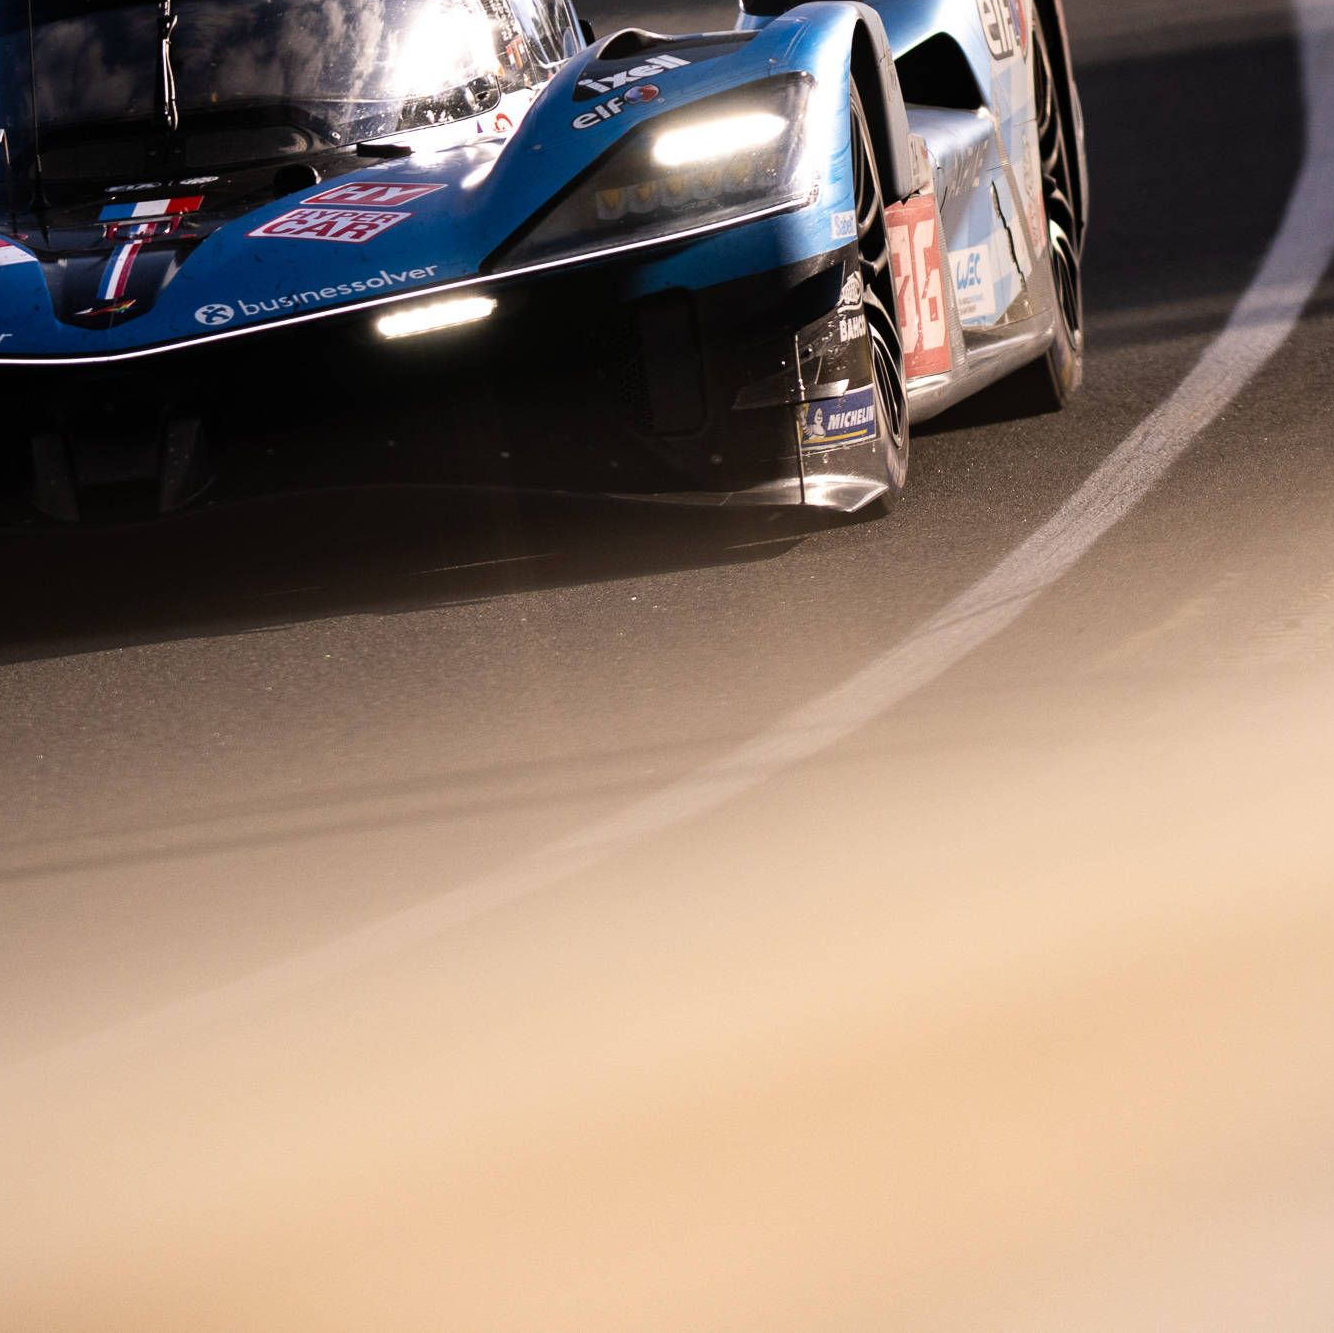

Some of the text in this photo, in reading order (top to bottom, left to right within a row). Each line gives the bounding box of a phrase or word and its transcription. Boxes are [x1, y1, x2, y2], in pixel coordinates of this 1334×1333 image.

[578, 54, 692, 93] ixell
[571, 97, 624, 129] elf
[325, 185, 421, 202] HY
[261, 219, 380, 240] CAR
[285, 209, 398, 224] HYPER
[888, 218, 946, 354] 36
[956, 253, 981, 291] WEC
[237, 266, 438, 316] businessolver
[827, 404, 875, 431] MICHELIN
